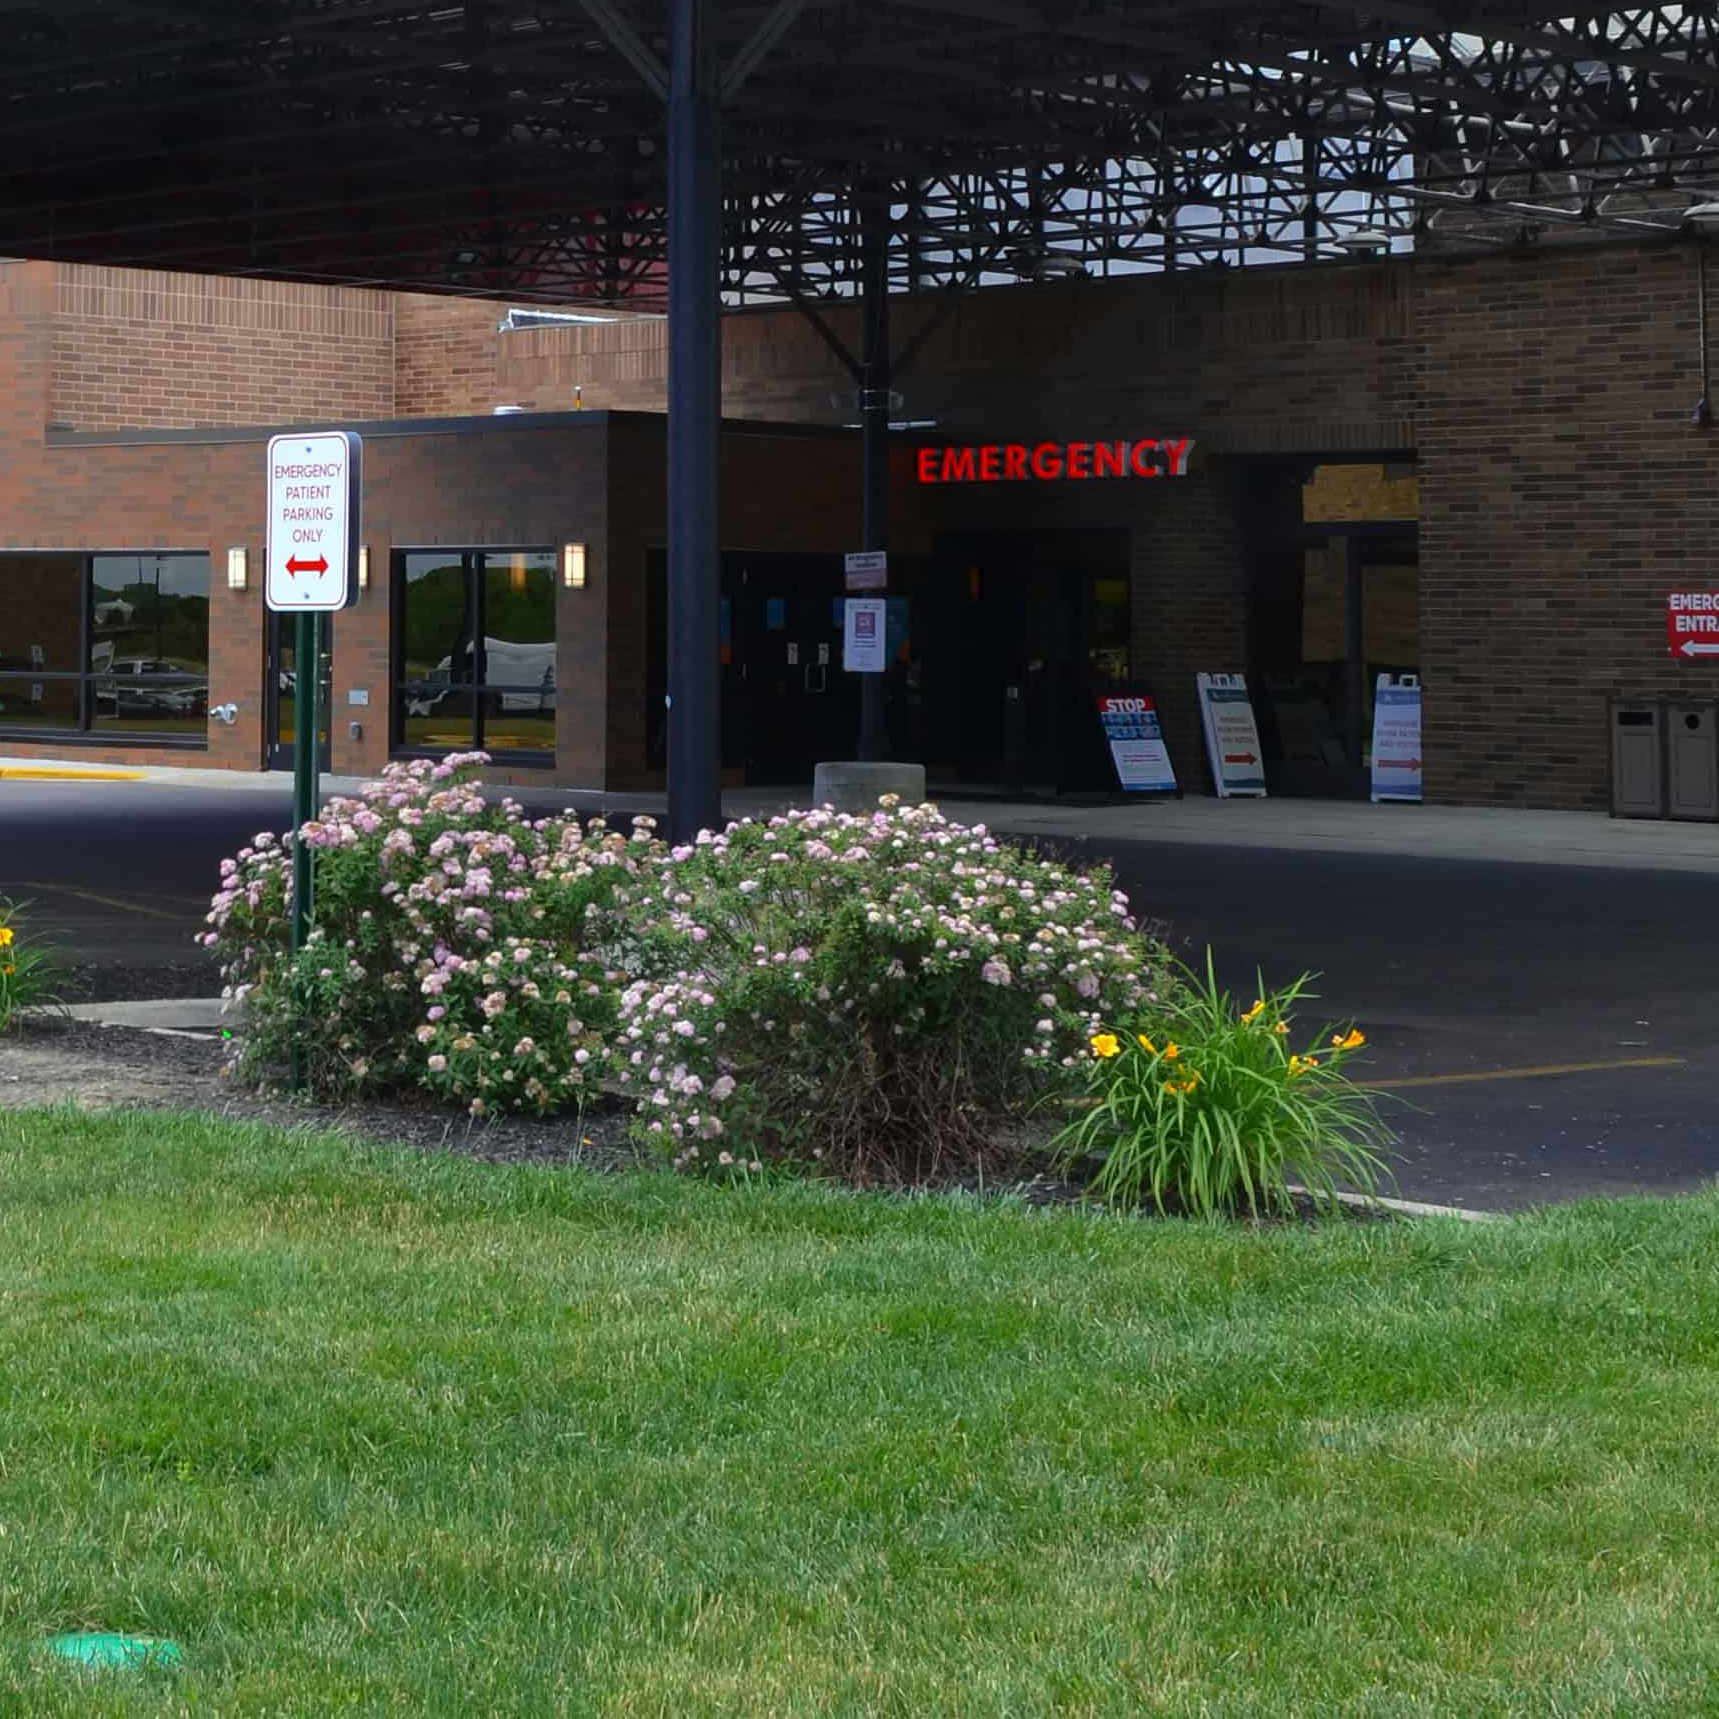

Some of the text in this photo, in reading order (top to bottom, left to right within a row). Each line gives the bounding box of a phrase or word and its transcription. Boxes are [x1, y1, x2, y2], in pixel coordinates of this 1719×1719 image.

[917, 437, 1195, 483] EMERGENCY
[274, 464, 343, 479] EMERGENCY
[286, 485, 331, 500] PATIENT
[283, 507, 333, 521] PARKING
[292, 528, 323, 543] ONLY
[1105, 698, 1145, 713] STOP
